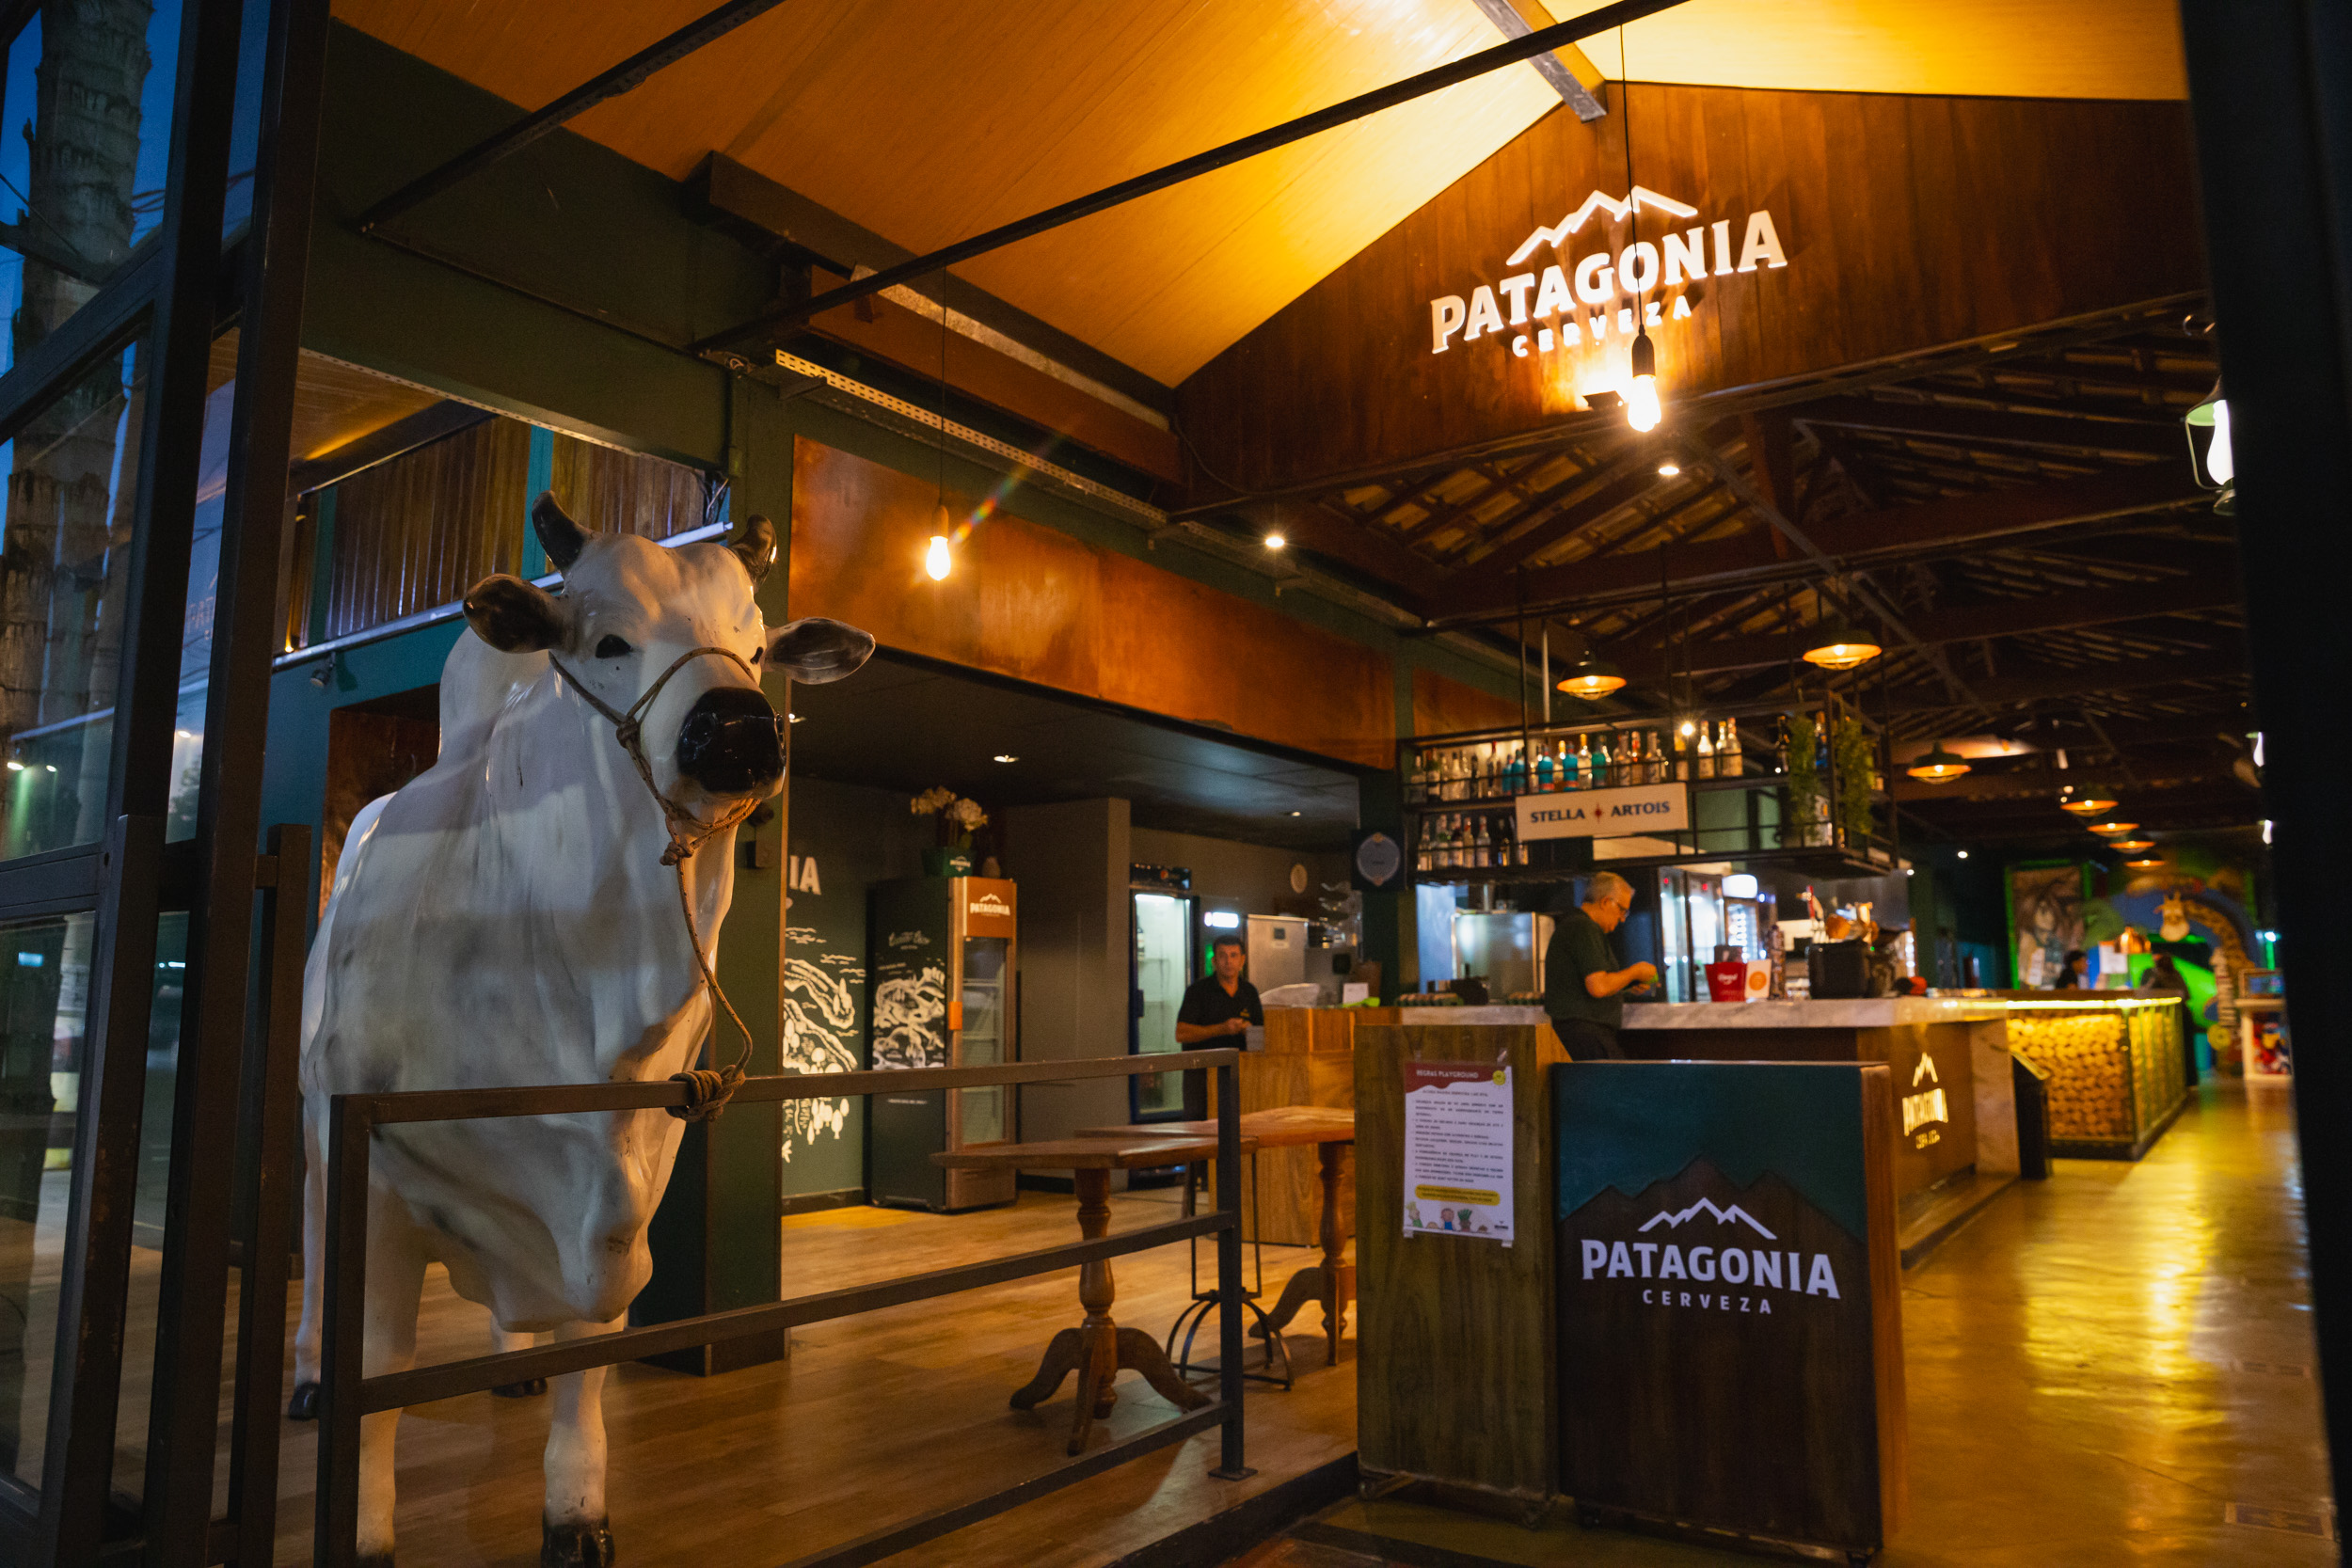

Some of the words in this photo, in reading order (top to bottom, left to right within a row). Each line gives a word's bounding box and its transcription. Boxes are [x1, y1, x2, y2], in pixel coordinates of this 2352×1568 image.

[1431, 210, 1788, 355] PATAGONIA
[1512, 295, 1692, 357] CERVEZA
[1531, 808, 1585, 823] STELLA
[1611, 800, 1670, 817] ARTOIS
[1581, 1239, 1841, 1300] PATAGONIA
[1643, 1289, 1772, 1315] CERVEZA
